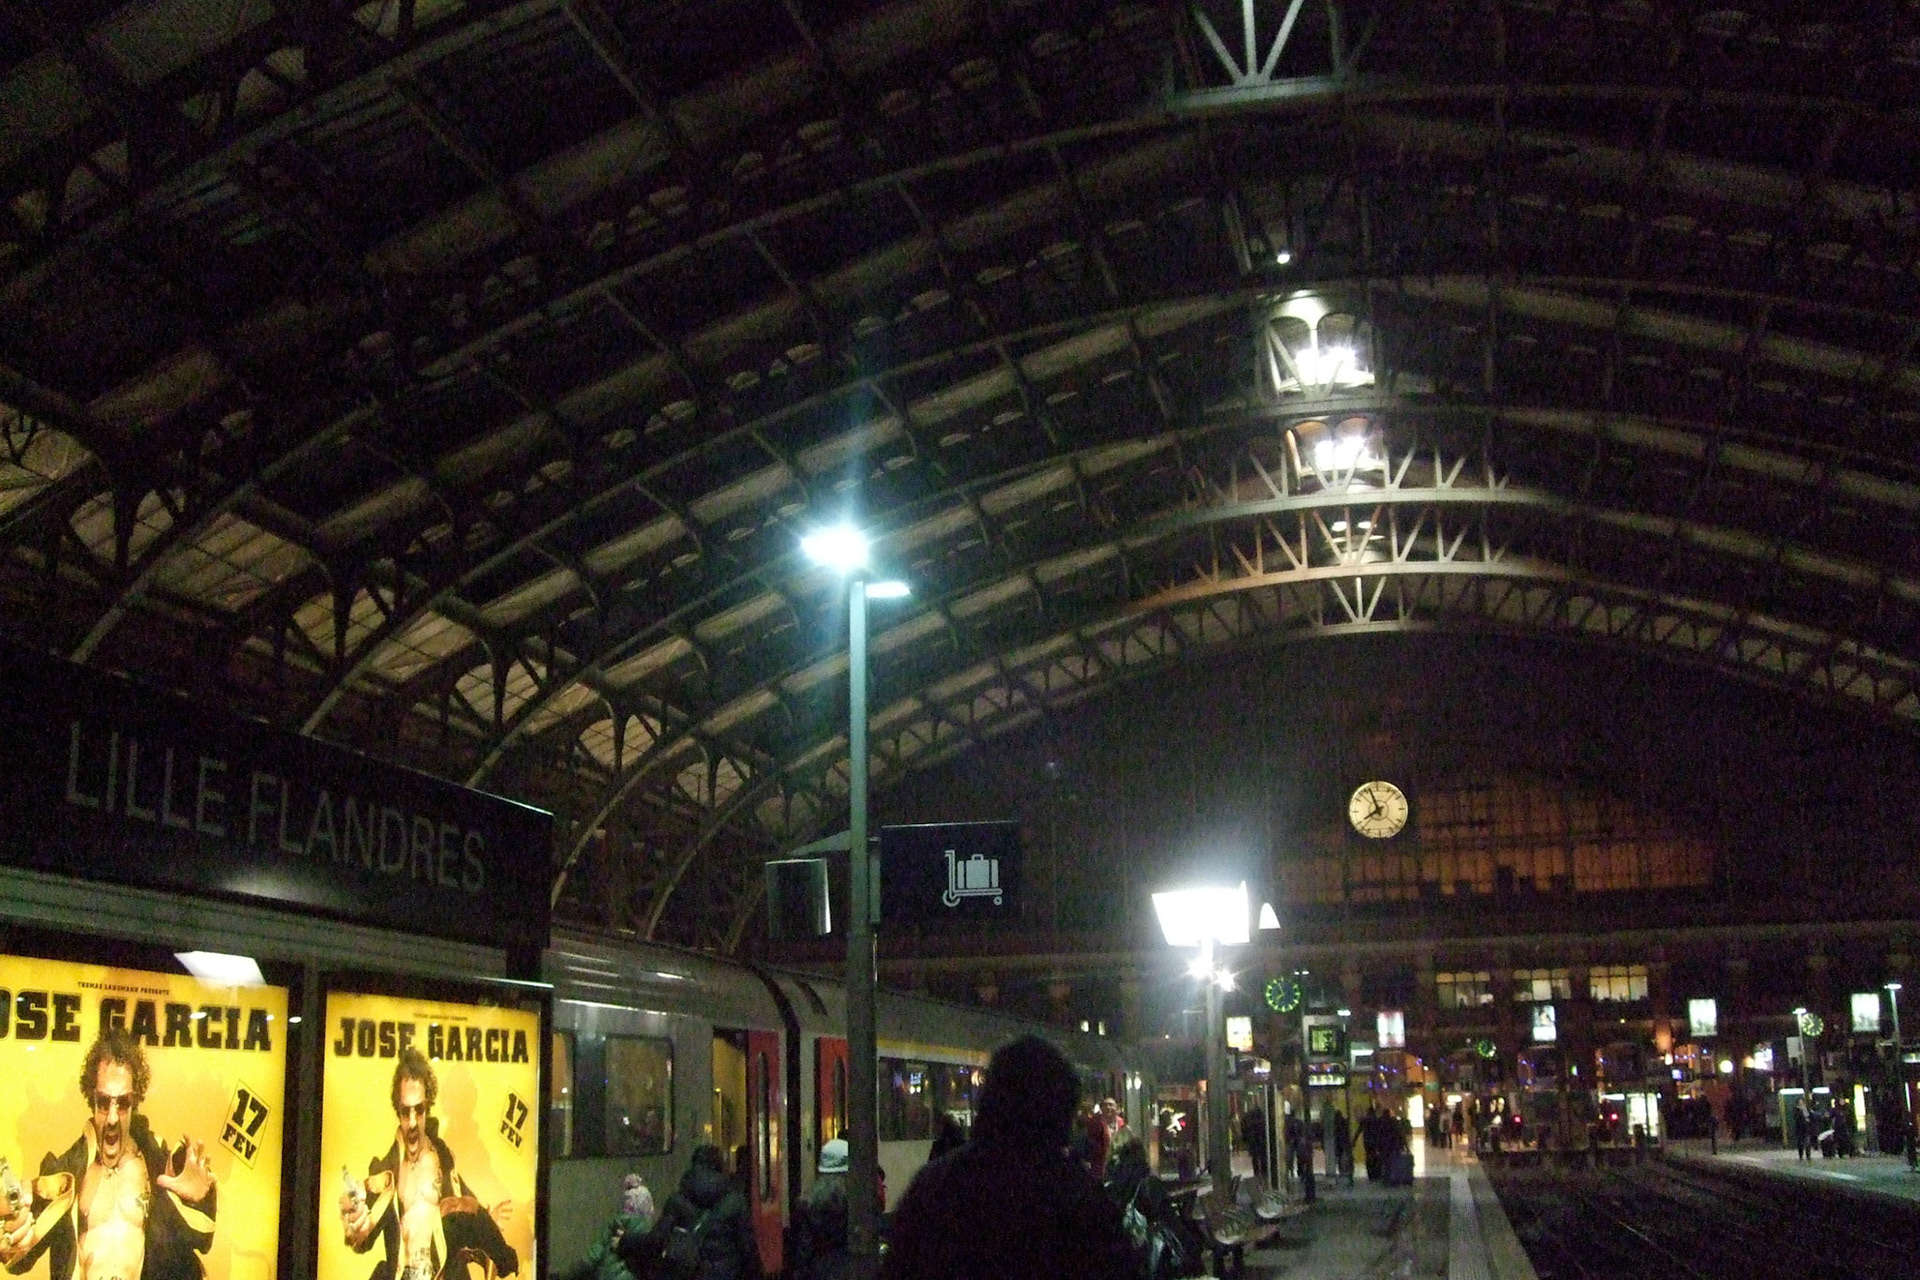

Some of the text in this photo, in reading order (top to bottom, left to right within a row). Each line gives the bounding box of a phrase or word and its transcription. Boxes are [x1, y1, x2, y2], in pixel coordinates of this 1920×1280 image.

[68, 720, 487, 893] LILLE FLANDRES
[99, 997, 272, 1051] GARCIA
[334, 1016, 528, 1063] JOSE GARCIA
[231, 1088, 269, 1138] 17
[500, 1120, 523, 1148] FEV
[505, 1092, 528, 1130] 17
[222, 1122, 257, 1161] FEV
